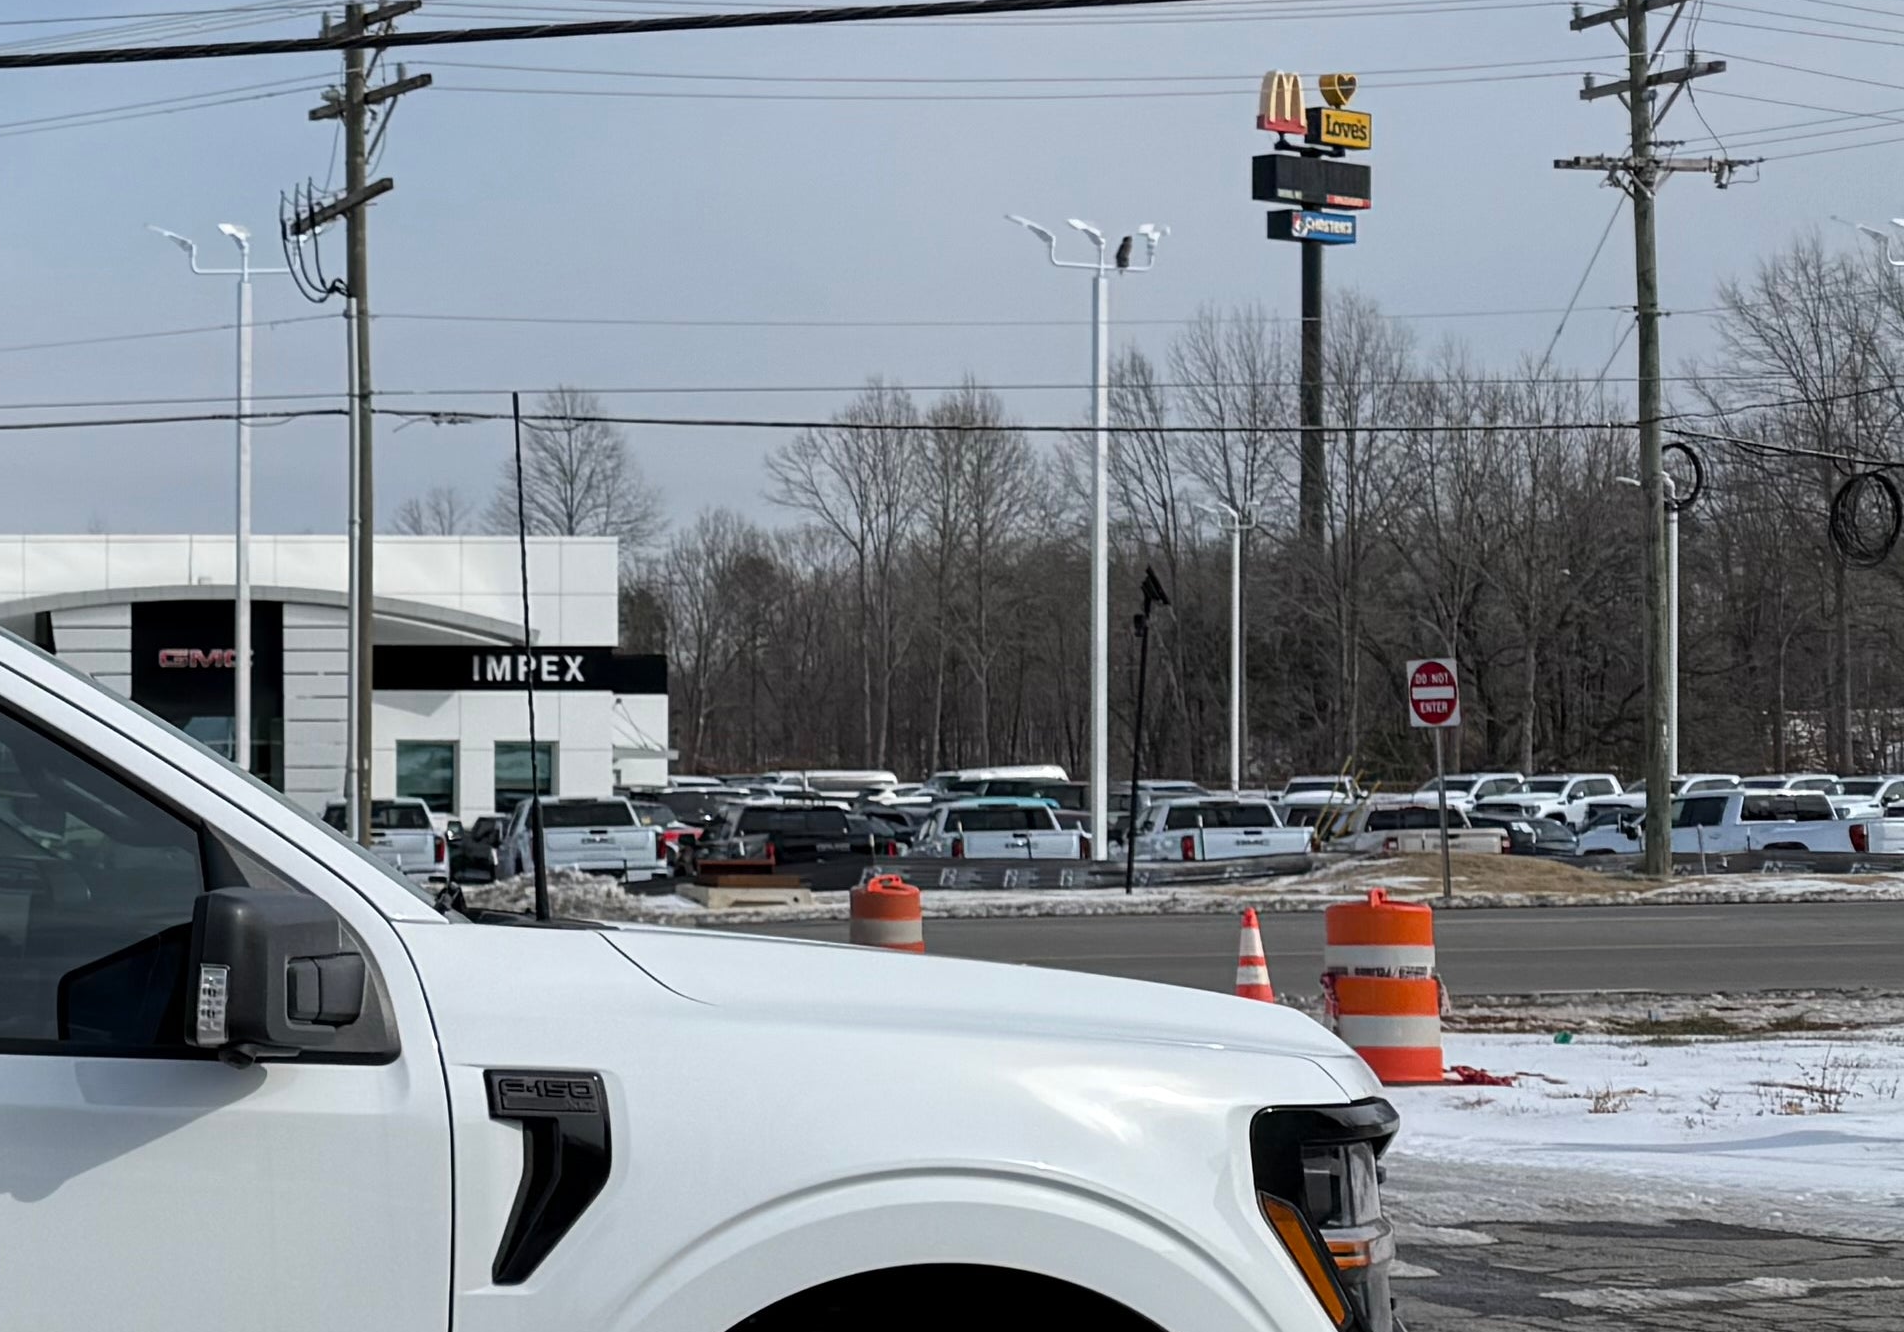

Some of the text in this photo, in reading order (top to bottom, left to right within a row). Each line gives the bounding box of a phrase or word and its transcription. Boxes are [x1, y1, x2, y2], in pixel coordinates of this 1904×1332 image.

[1325, 113, 1367, 141] Love's
[472, 654, 585, 682] IMPEX
[1415, 672, 1449, 685] DO NOT
[1420, 701, 1448, 714] ENTER
